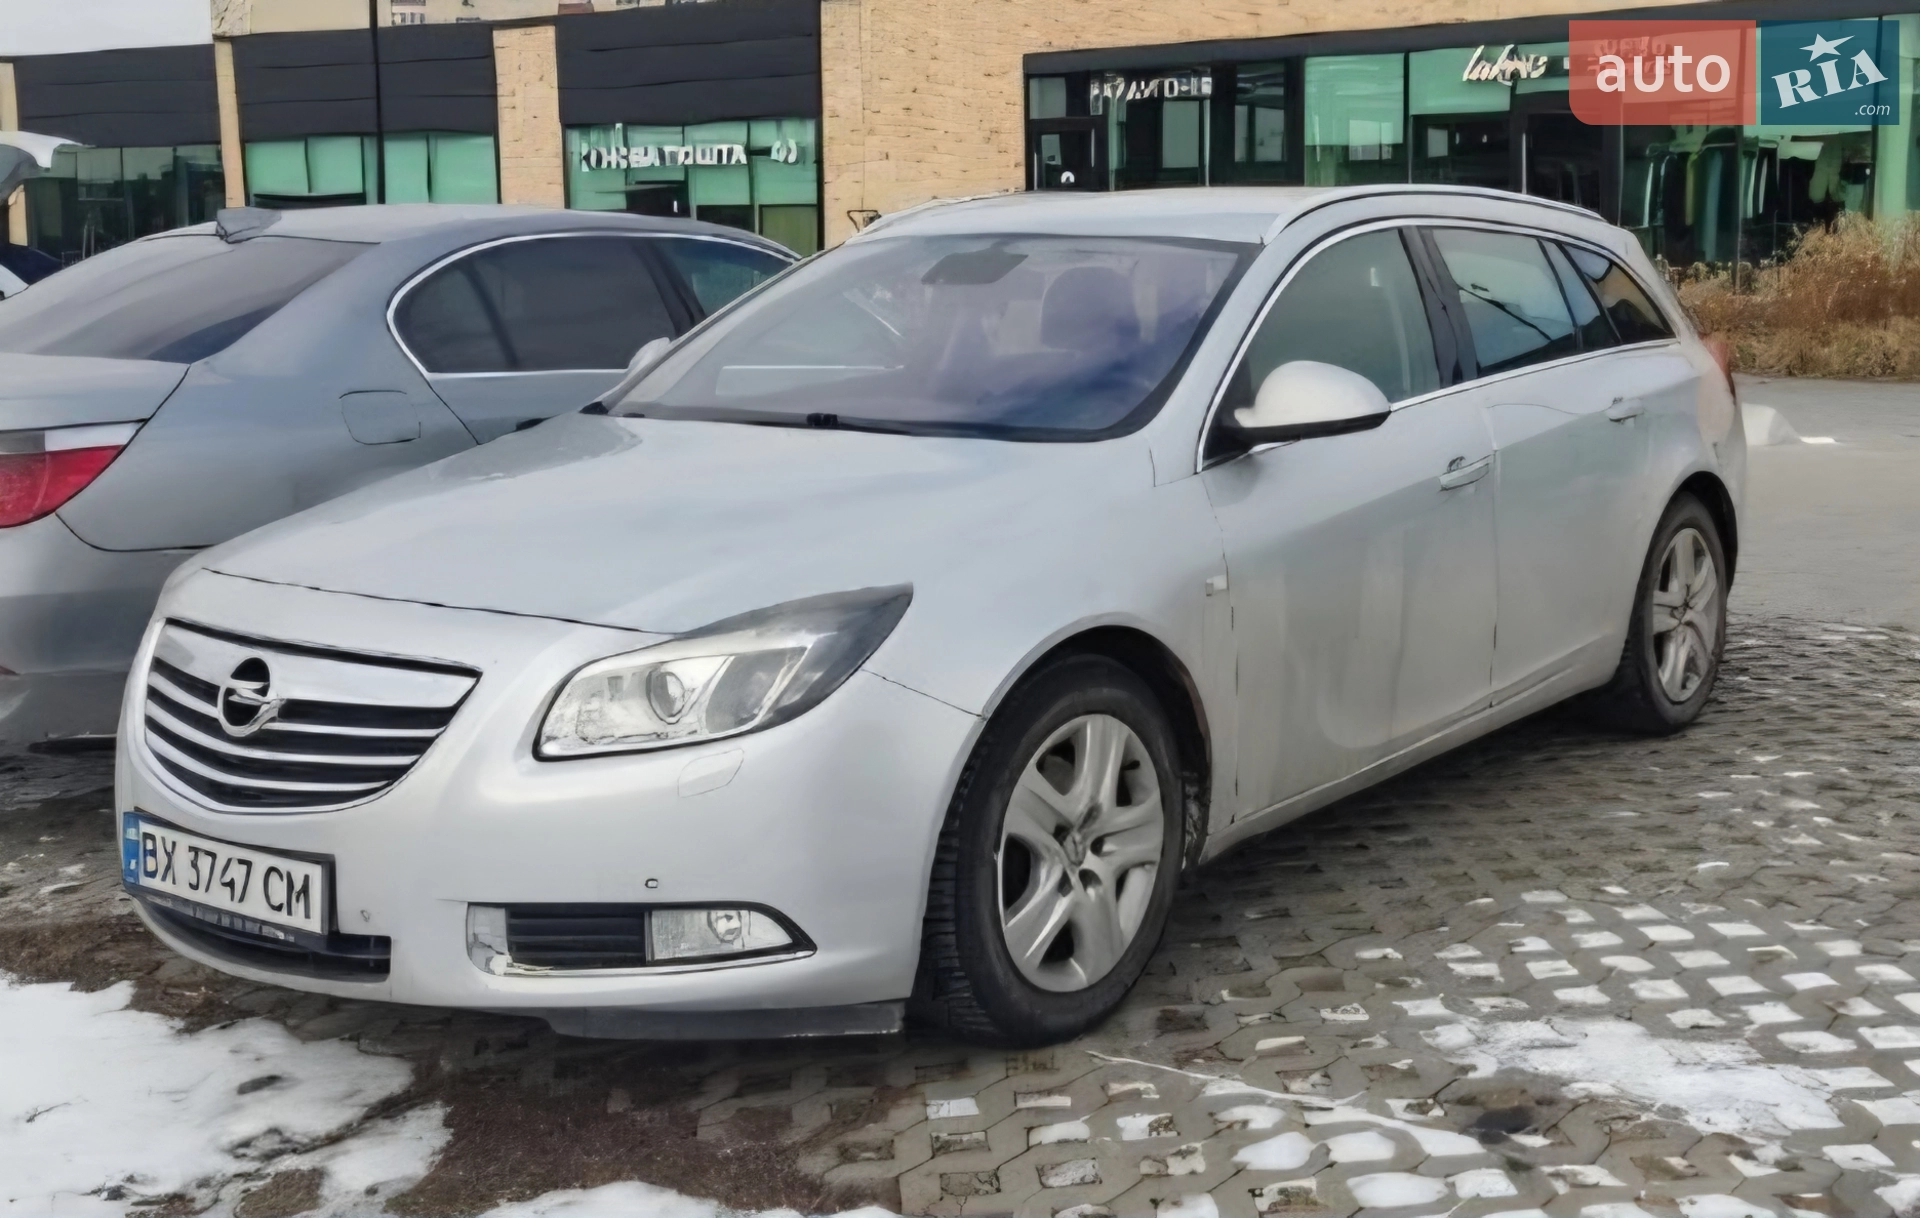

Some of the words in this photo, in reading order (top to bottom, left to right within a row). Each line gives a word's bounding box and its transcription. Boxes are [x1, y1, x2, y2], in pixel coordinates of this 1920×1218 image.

[142, 831, 177, 886] BX
[188, 845, 253, 904] 3747
[263, 866, 312, 920] CM
